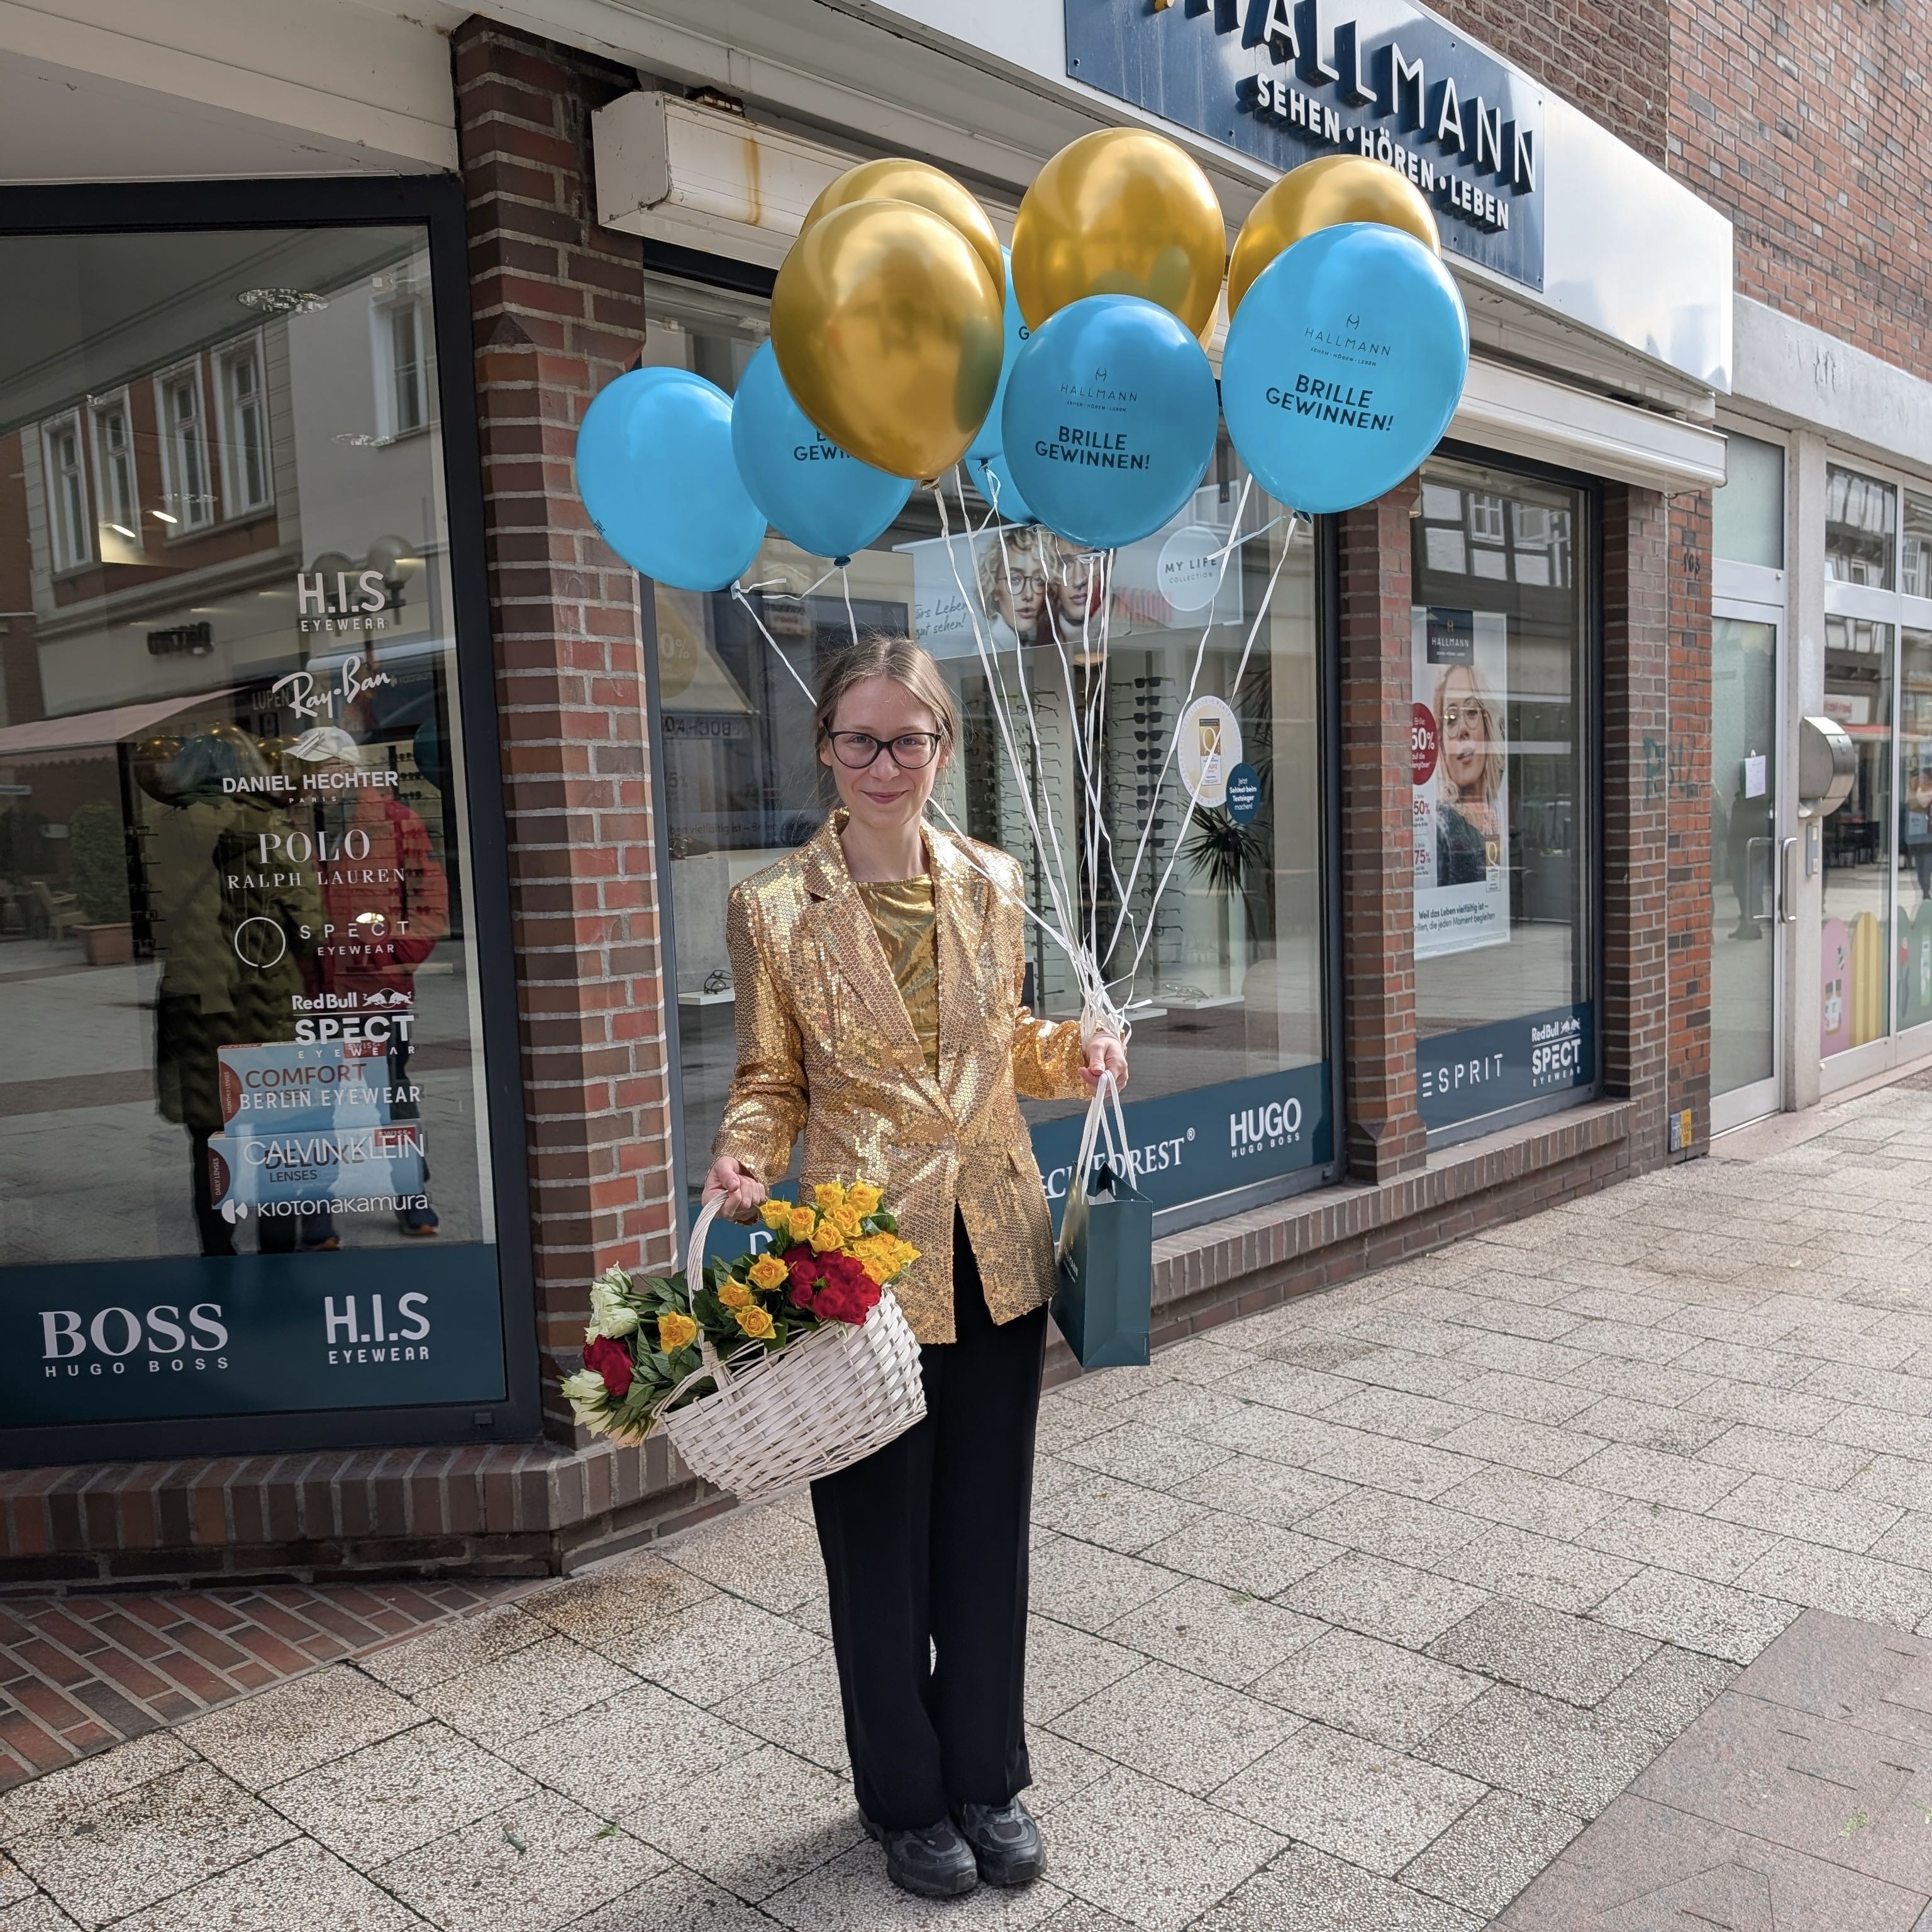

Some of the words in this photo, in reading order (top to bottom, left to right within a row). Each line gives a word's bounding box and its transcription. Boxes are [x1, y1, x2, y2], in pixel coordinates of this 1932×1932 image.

[1257, 72, 1341, 144] SEHEN
[1360, 126, 1435, 191] HÖREN
[1451, 174, 1509, 230] LEBEN
[1304, 327, 1391, 356] HALLMANN
[1060, 383, 1138, 402] HALLMANN
[1295, 374, 1373, 408] BRILLE
[1265, 387, 1394, 431] GEWINNEN!
[1058, 426, 1128, 450] BRILLE
[1035, 440, 1151, 470] GEWINNEN!
[1165, 561, 1183, 574] MY
[1189, 557, 1217, 570] LIFE
[1169, 572, 1213, 584] COLLECTION
[297, 570, 386, 614] H.I.S
[301, 618, 386, 632] EYEWEAR
[933, 612, 967, 634] sehen!
[1431, 636, 1470, 647] HALLMANN
[223, 775, 297, 793] DANIEL
[303, 771, 399, 789] HECHTER
[289, 796, 337, 804] PARIS
[1414, 800, 1431, 816] 50%
[257, 829, 370, 864] POLO
[1414, 849, 1431, 865] 75%
[227, 872, 302, 889] RALPH
[317, 867, 408, 886] LAUREN
[1440, 906, 1456, 917] Leben
[299, 921, 409, 940] SPECT
[318, 944, 395, 956] EYEWEAR
[295, 1014, 415, 1046] SPECT
[1531, 1038, 1582, 1075] SPECT
[245, 1063, 367, 1090] COMFORT
[1422, 1053, 1504, 1098] ESPRIT
[239, 1091, 313, 1111] BERLIN
[321, 1085, 422, 1106] EYEWEAR
[1230, 1097, 1302, 1148] HUGO
[243, 1138, 343, 1165] CALVIN
[351, 1133, 426, 1160] KLEIN
[1231, 1142, 1263, 1158] HUGO
[1270, 1132, 1300, 1148] BOSS
[269, 1170, 318, 1183] LENSES
[38, 1303, 229, 1359] BOSS
[324, 1292, 430, 1344] H.I.S
[45, 1360, 125, 1378] HUGO
[149, 1356, 230, 1373] BOSS
[328, 1346, 430, 1365] EYEWEAR
